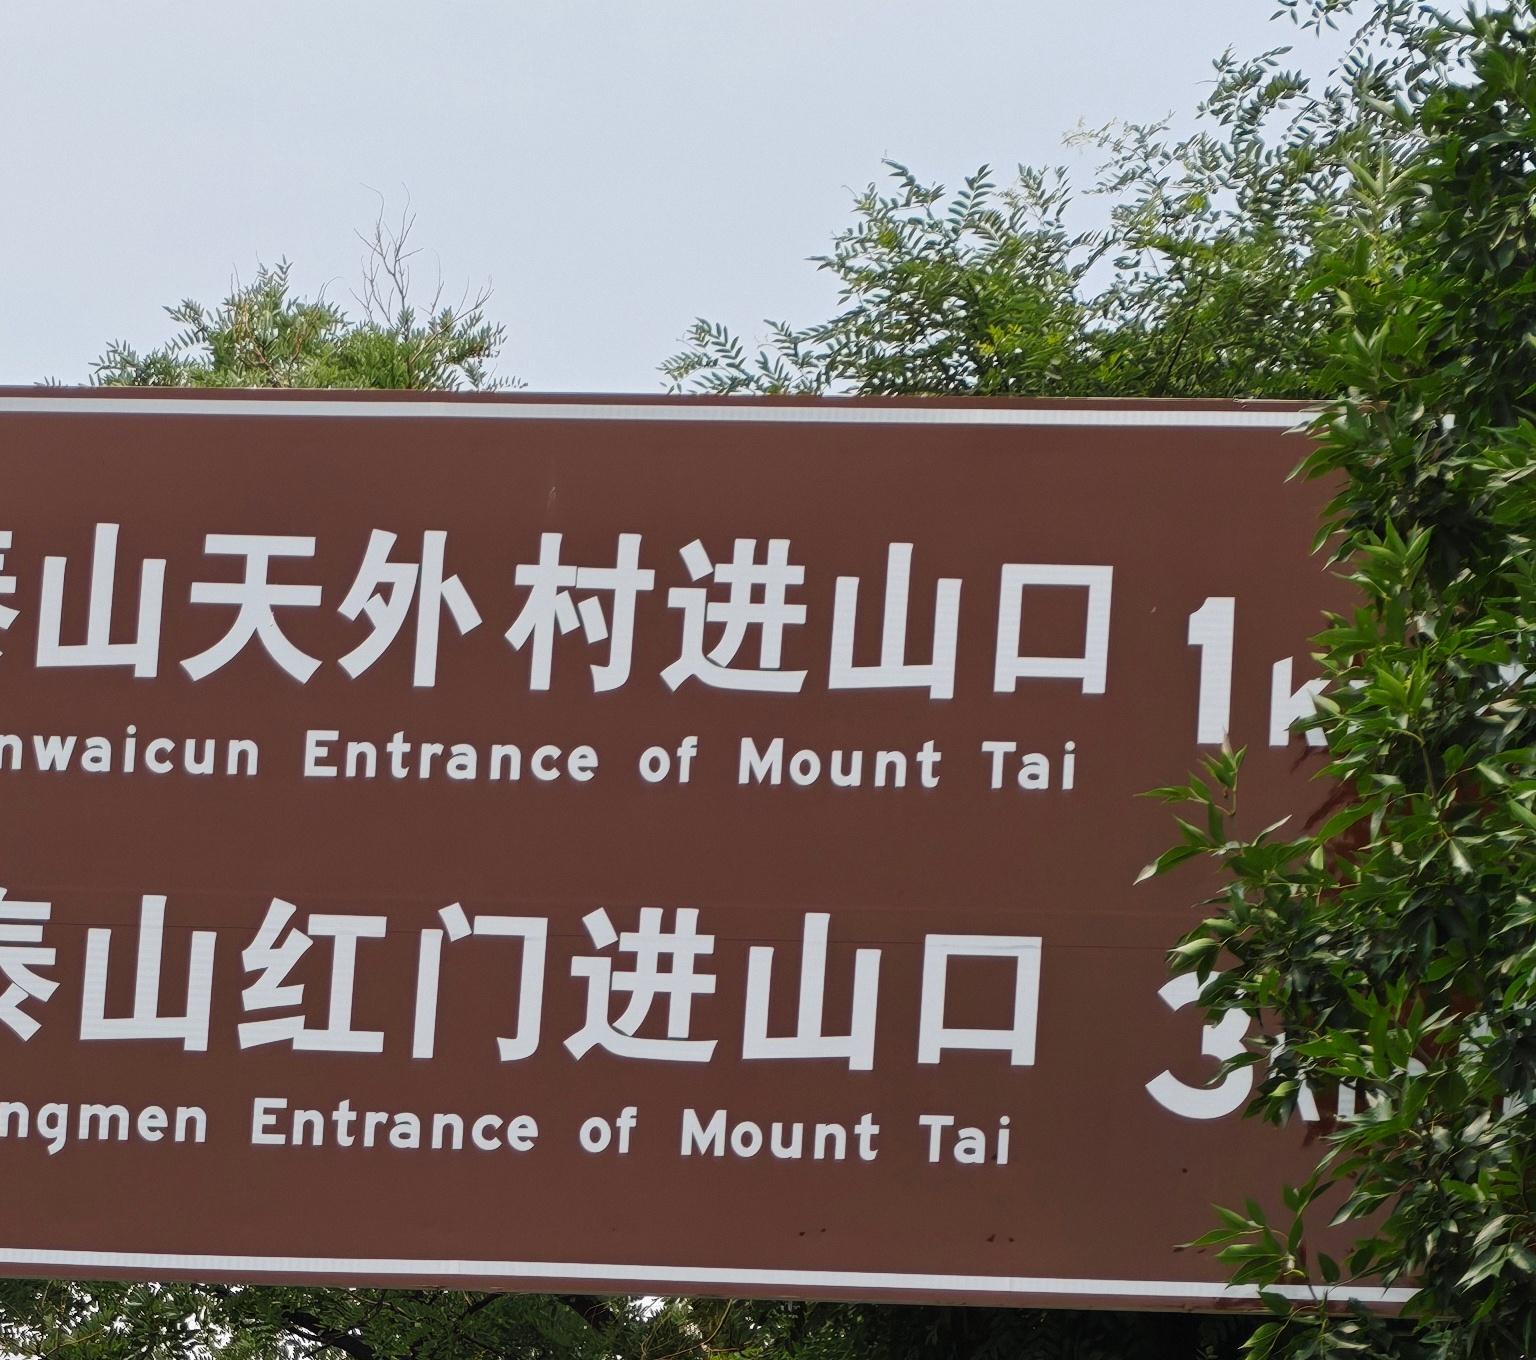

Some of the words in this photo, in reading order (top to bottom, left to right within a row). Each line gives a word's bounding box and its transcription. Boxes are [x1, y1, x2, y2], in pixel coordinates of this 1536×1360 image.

[303, 729, 599, 783] Entrance
[639, 735, 698, 784] of
[738, 737, 942, 789] Mount
[981, 740, 1077, 792] Tai
[251, 1097, 539, 1152] Entrance
[579, 1106, 638, 1154] of
[680, 1108, 880, 1161] Mount
[918, 1114, 1011, 1165] Tai
